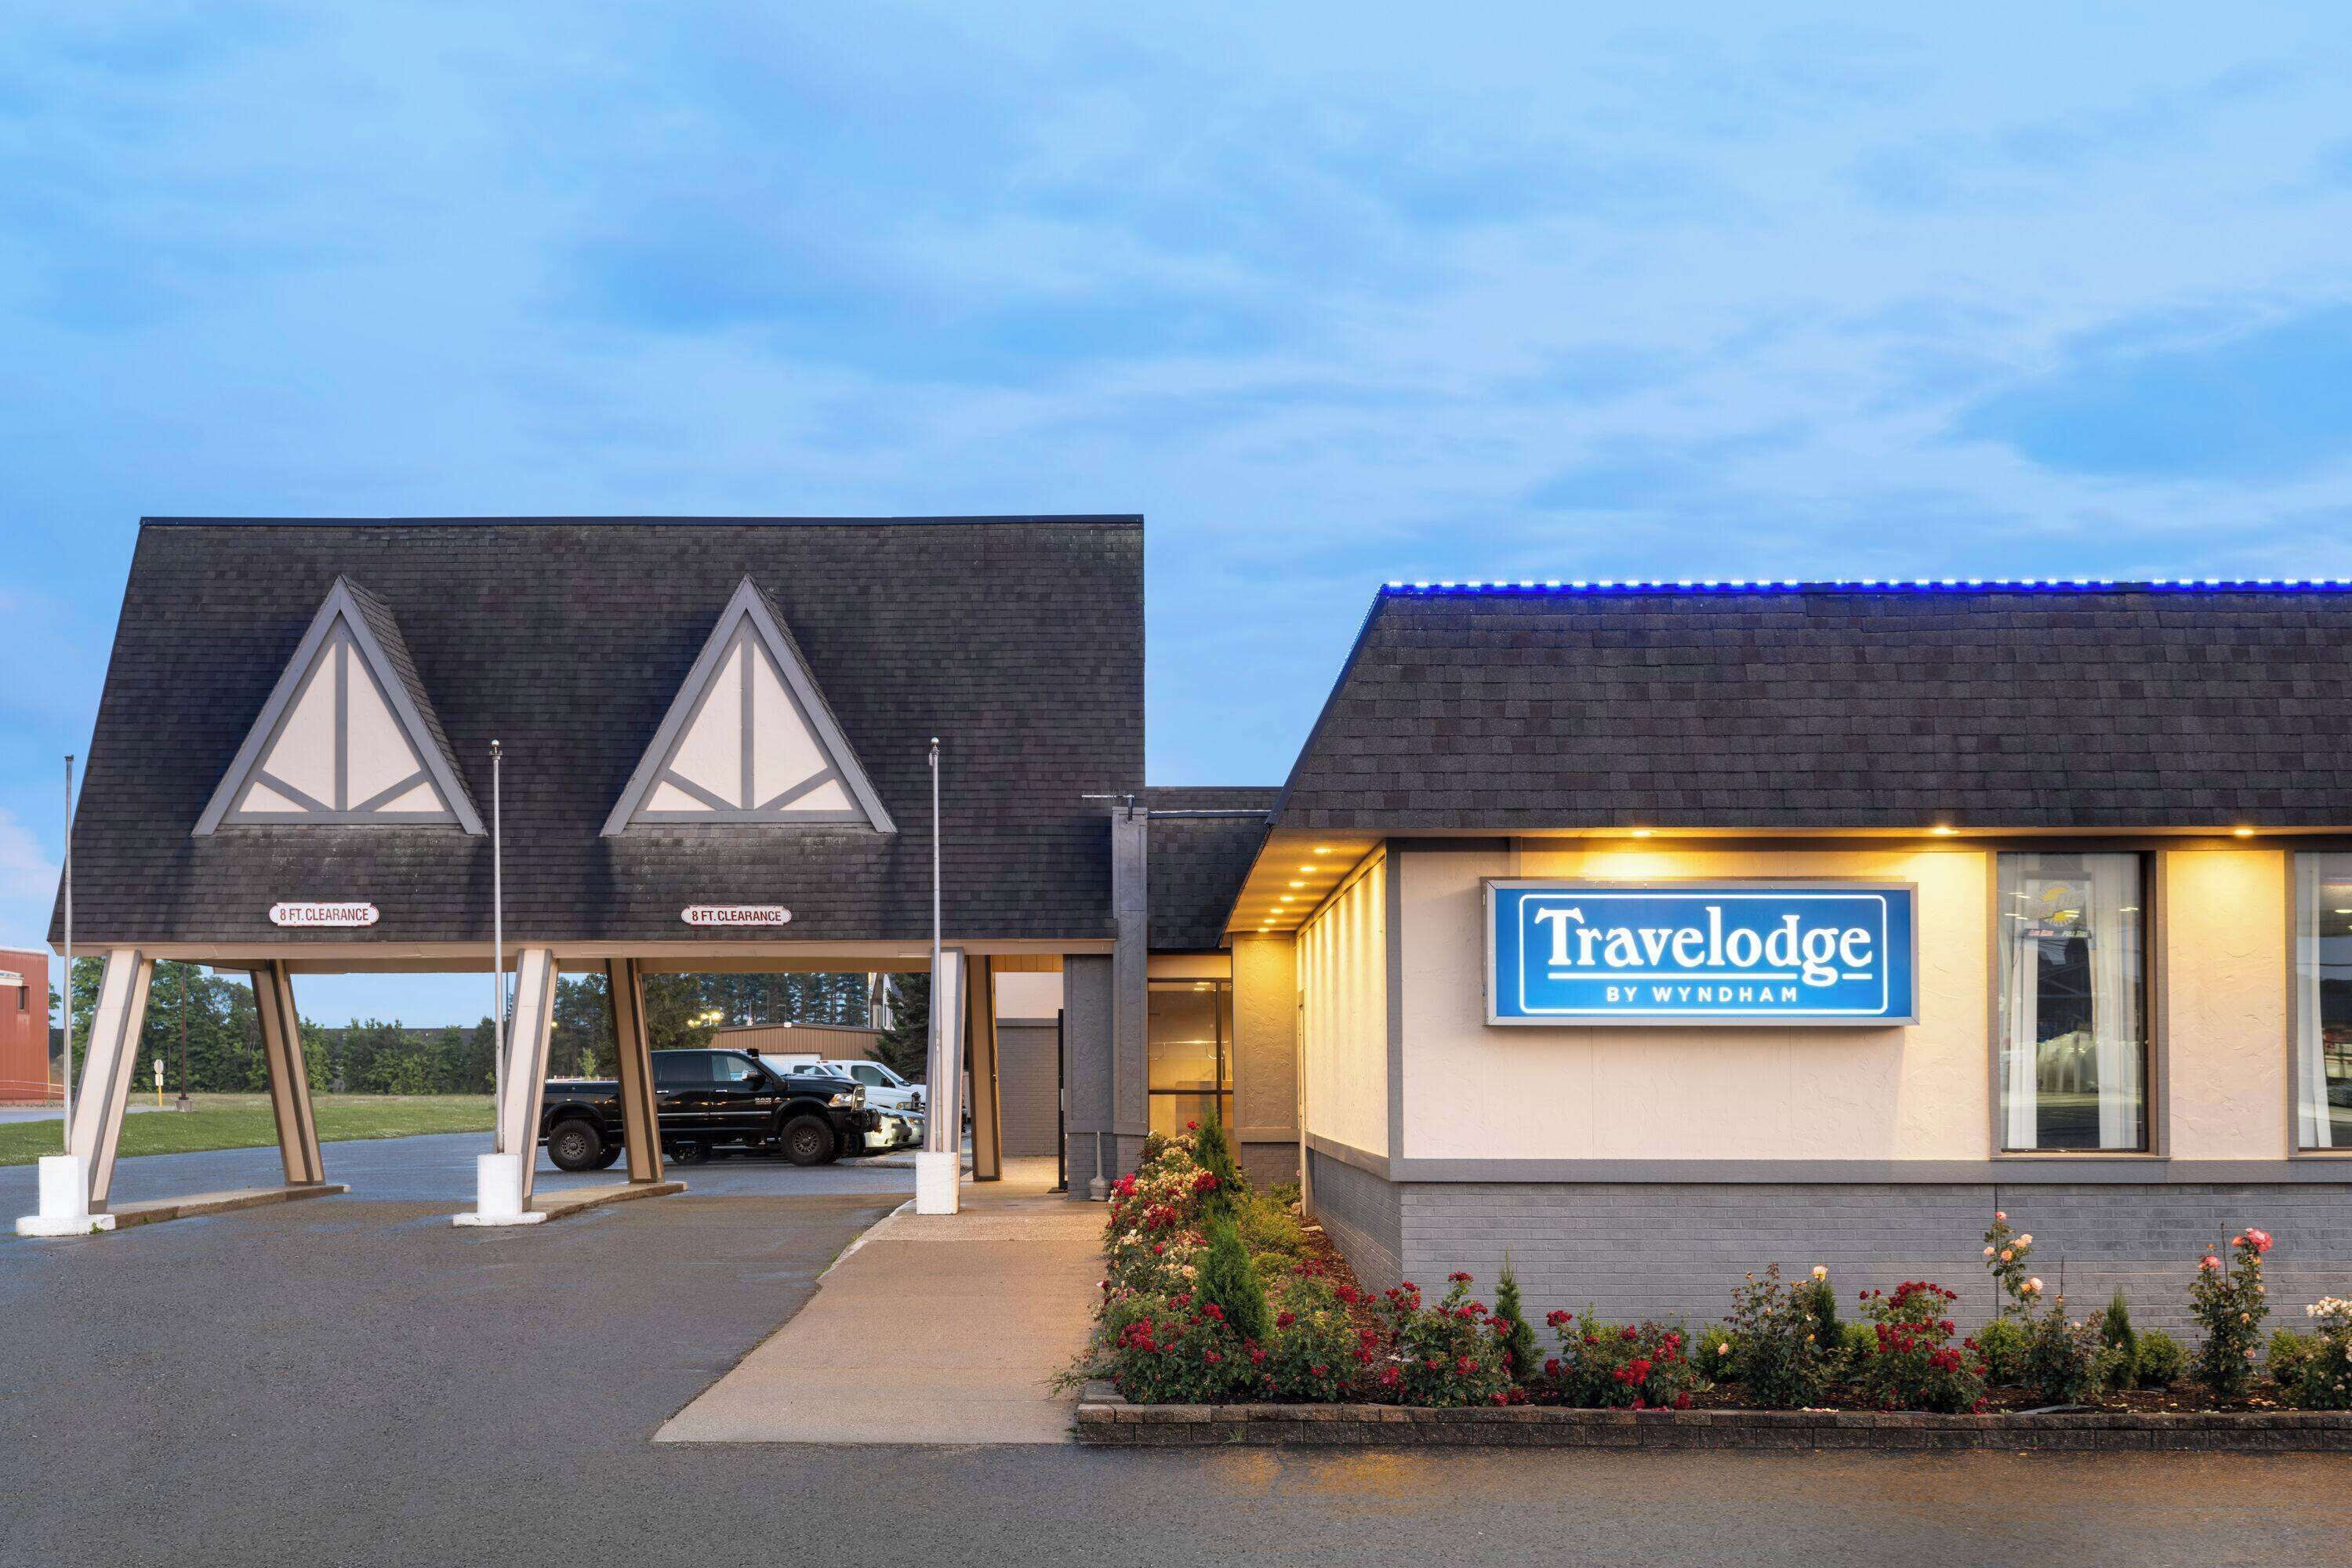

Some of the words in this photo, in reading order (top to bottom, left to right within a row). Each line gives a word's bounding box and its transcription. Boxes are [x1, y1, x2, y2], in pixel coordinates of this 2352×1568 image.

[280, 908, 286, 921] 8
[289, 908, 304, 921] FT.
[306, 908, 368, 921] CLEARANCE
[691, 910, 699, 921] 8
[701, 910, 716, 921] FT.
[717, 910, 782, 921] CLEARANCE
[1534, 906, 1873, 987] Travelodge
[1606, 986, 1638, 1003] BY
[1653, 986, 1798, 1003] WYNDHAM
